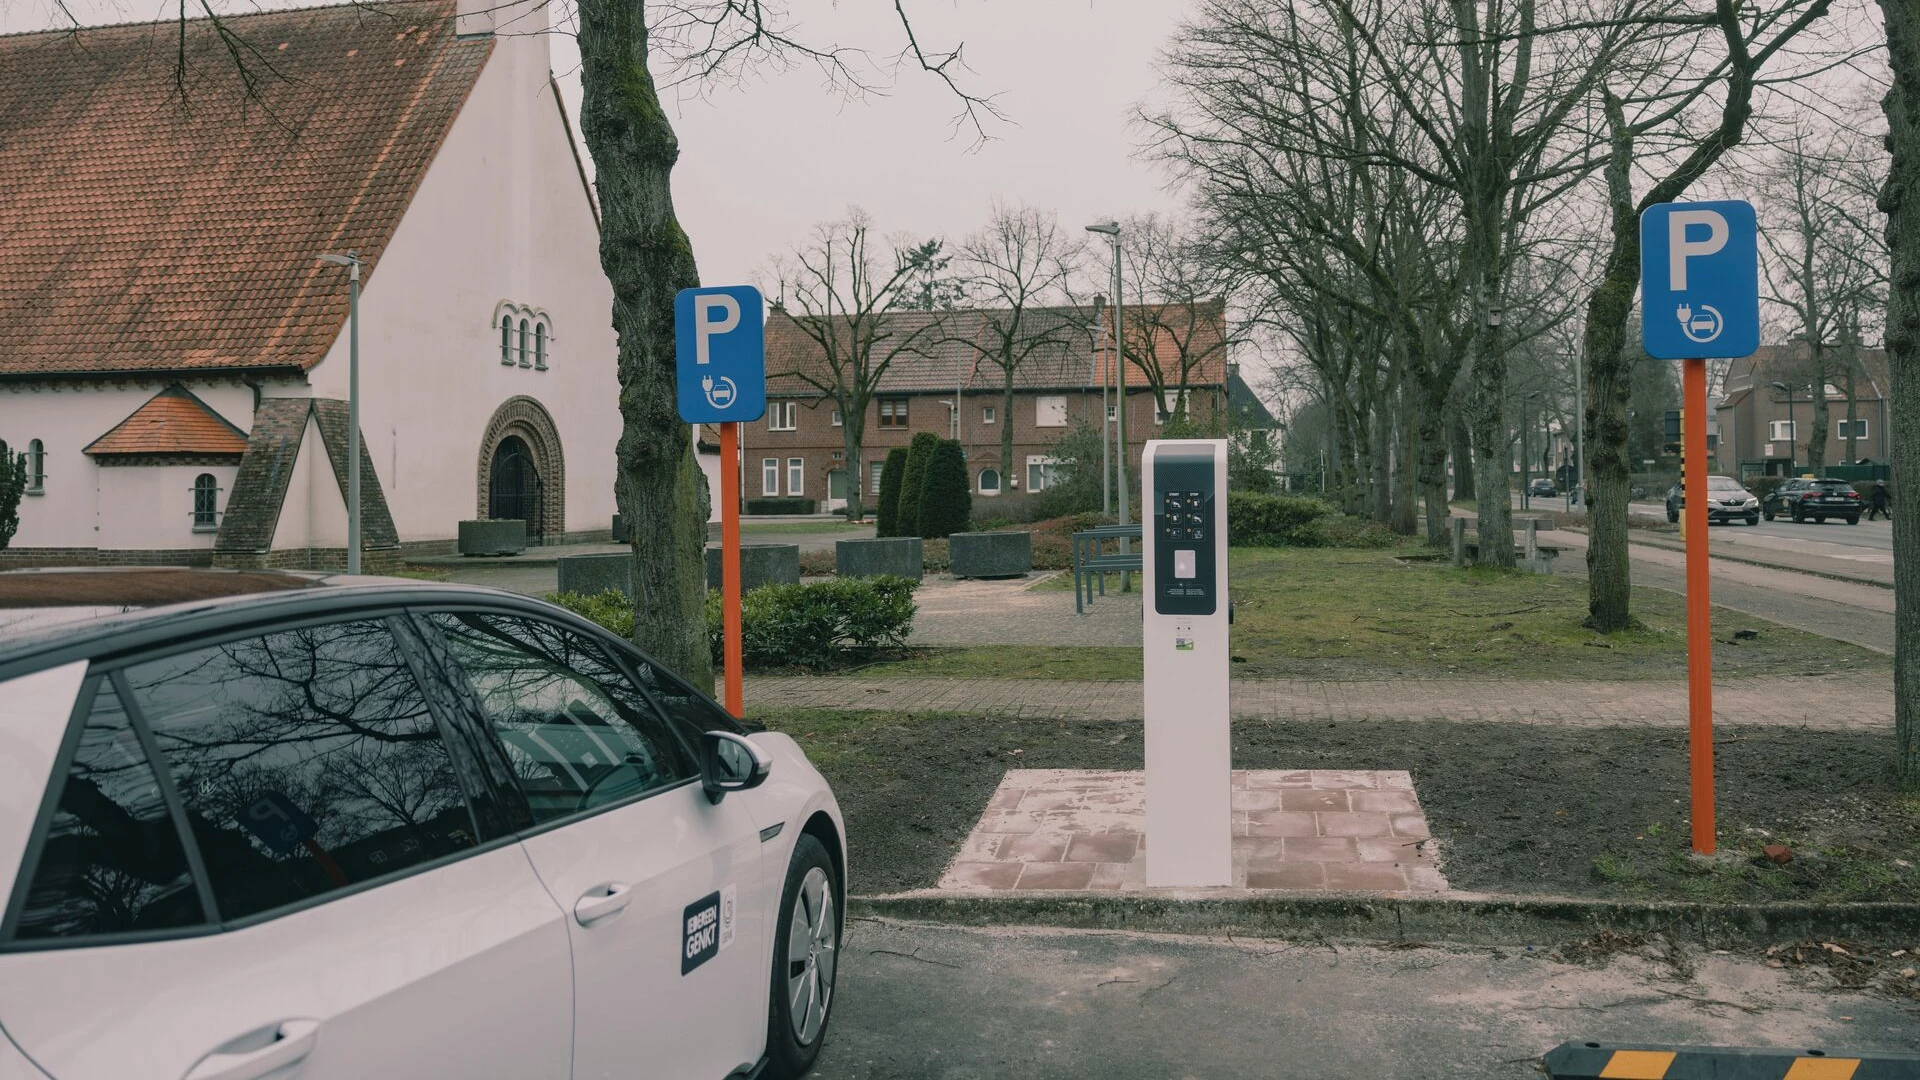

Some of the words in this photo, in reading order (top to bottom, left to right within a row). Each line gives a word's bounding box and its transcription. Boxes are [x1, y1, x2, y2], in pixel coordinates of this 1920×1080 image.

[1668, 209, 1730, 292] P
[694, 293, 741, 365] P
[686, 922, 717, 959] GENKT
